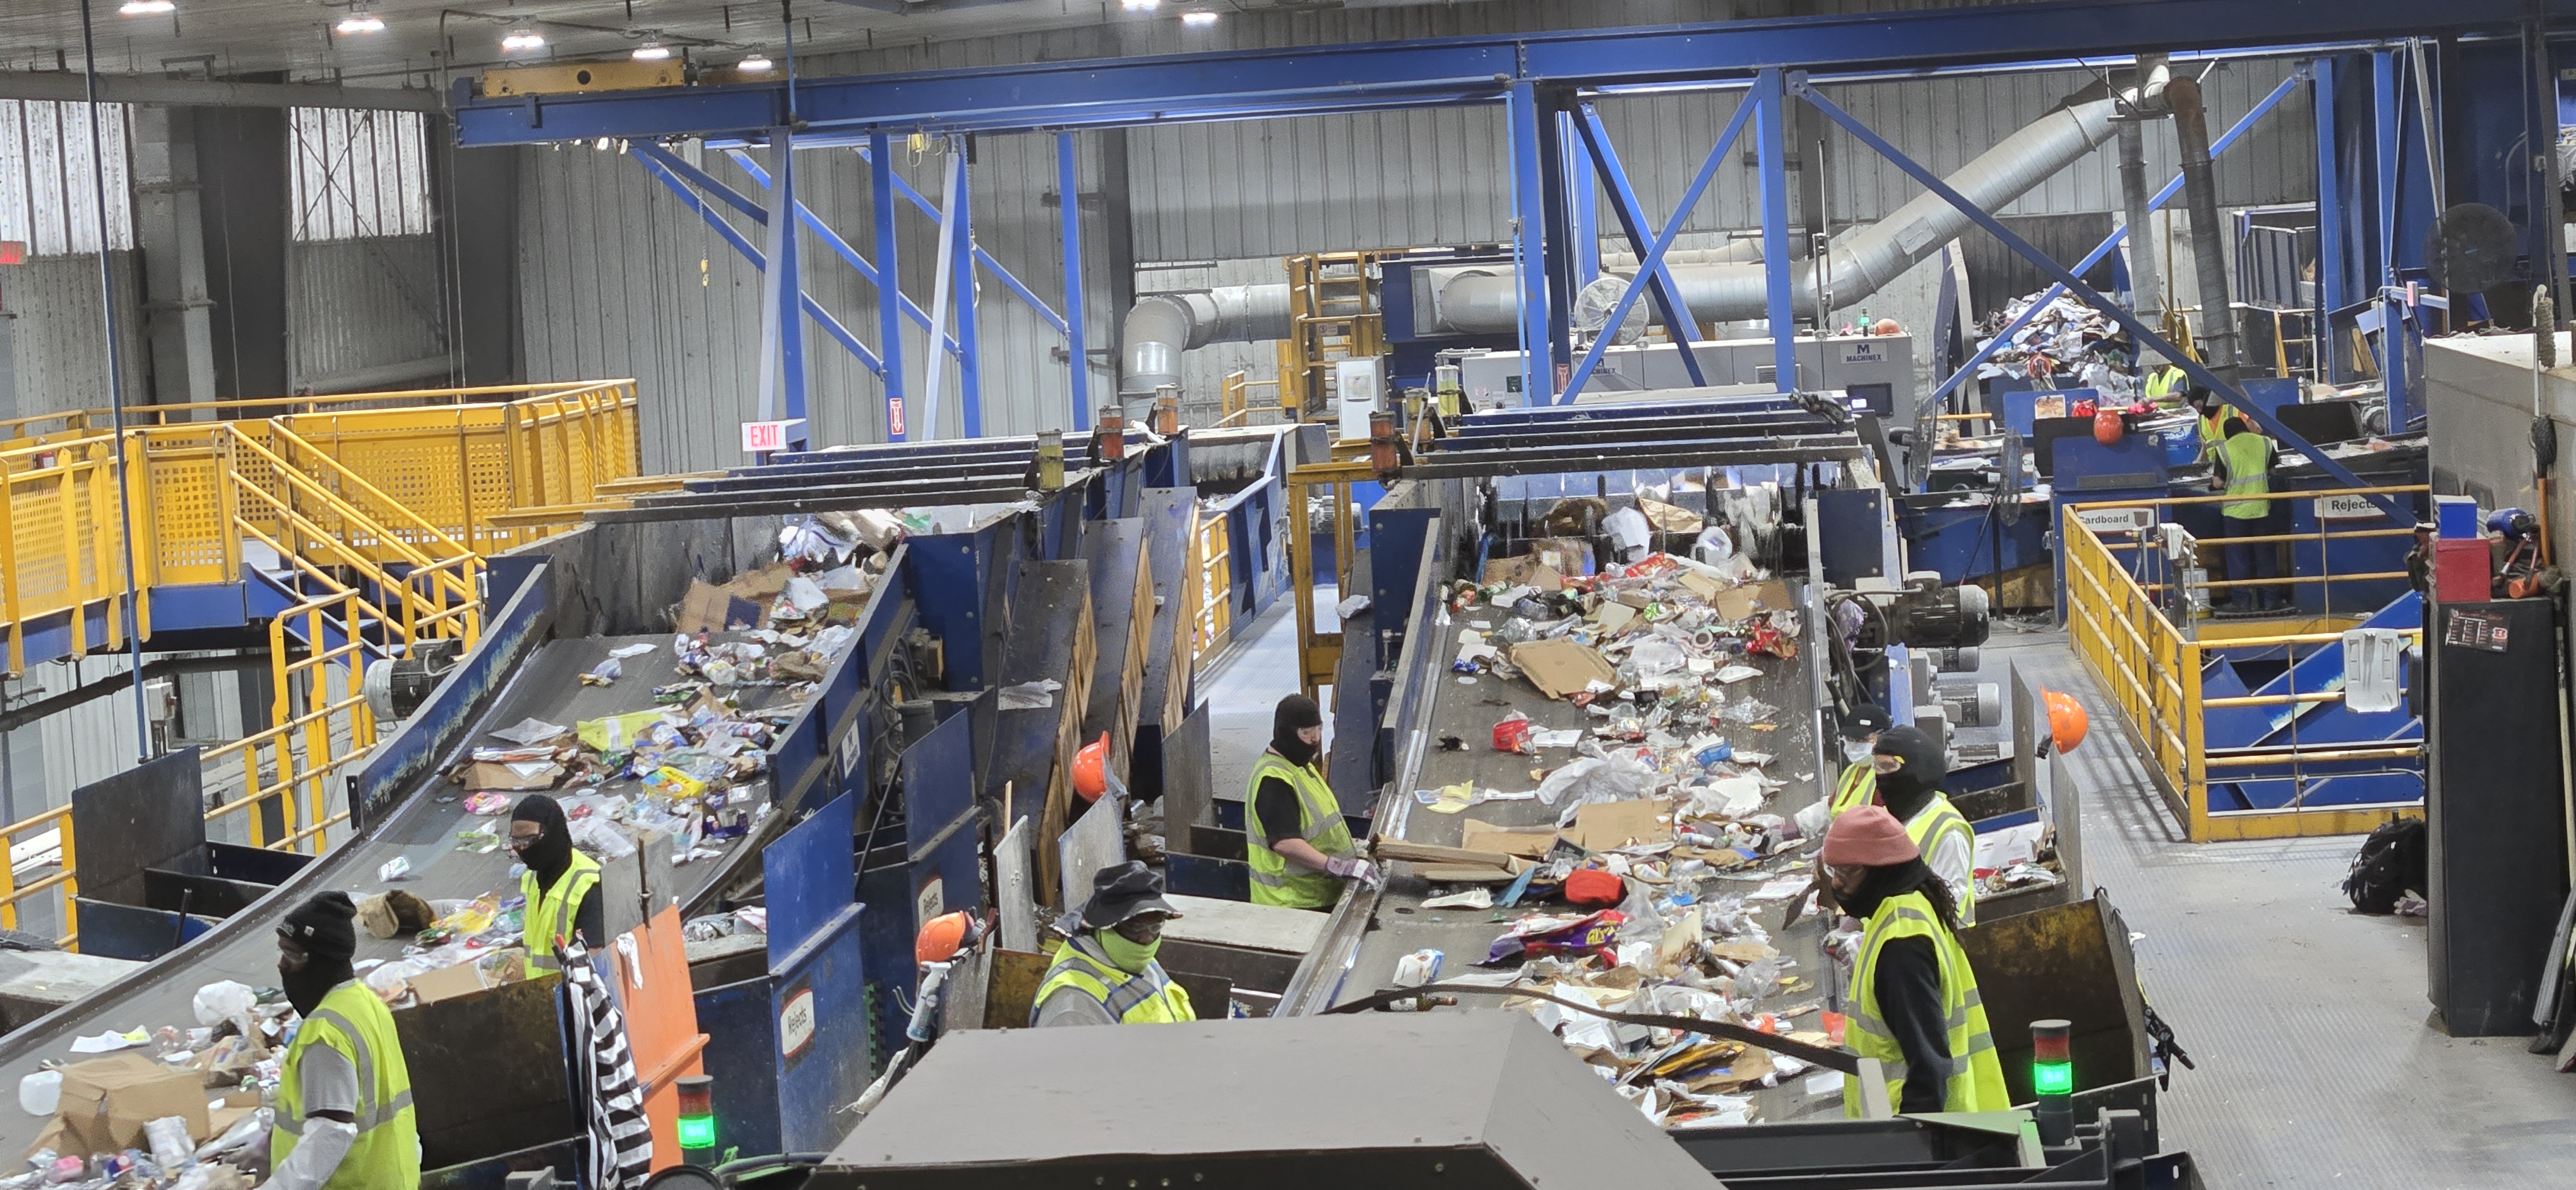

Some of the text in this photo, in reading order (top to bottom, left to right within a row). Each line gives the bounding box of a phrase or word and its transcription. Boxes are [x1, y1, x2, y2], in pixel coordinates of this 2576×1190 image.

[1857, 344, 1869, 354] M
[1846, 354, 1881, 363] MACHINEX
[750, 424, 778, 447] EXIT
[787, 1006, 807, 1036] Rejects
